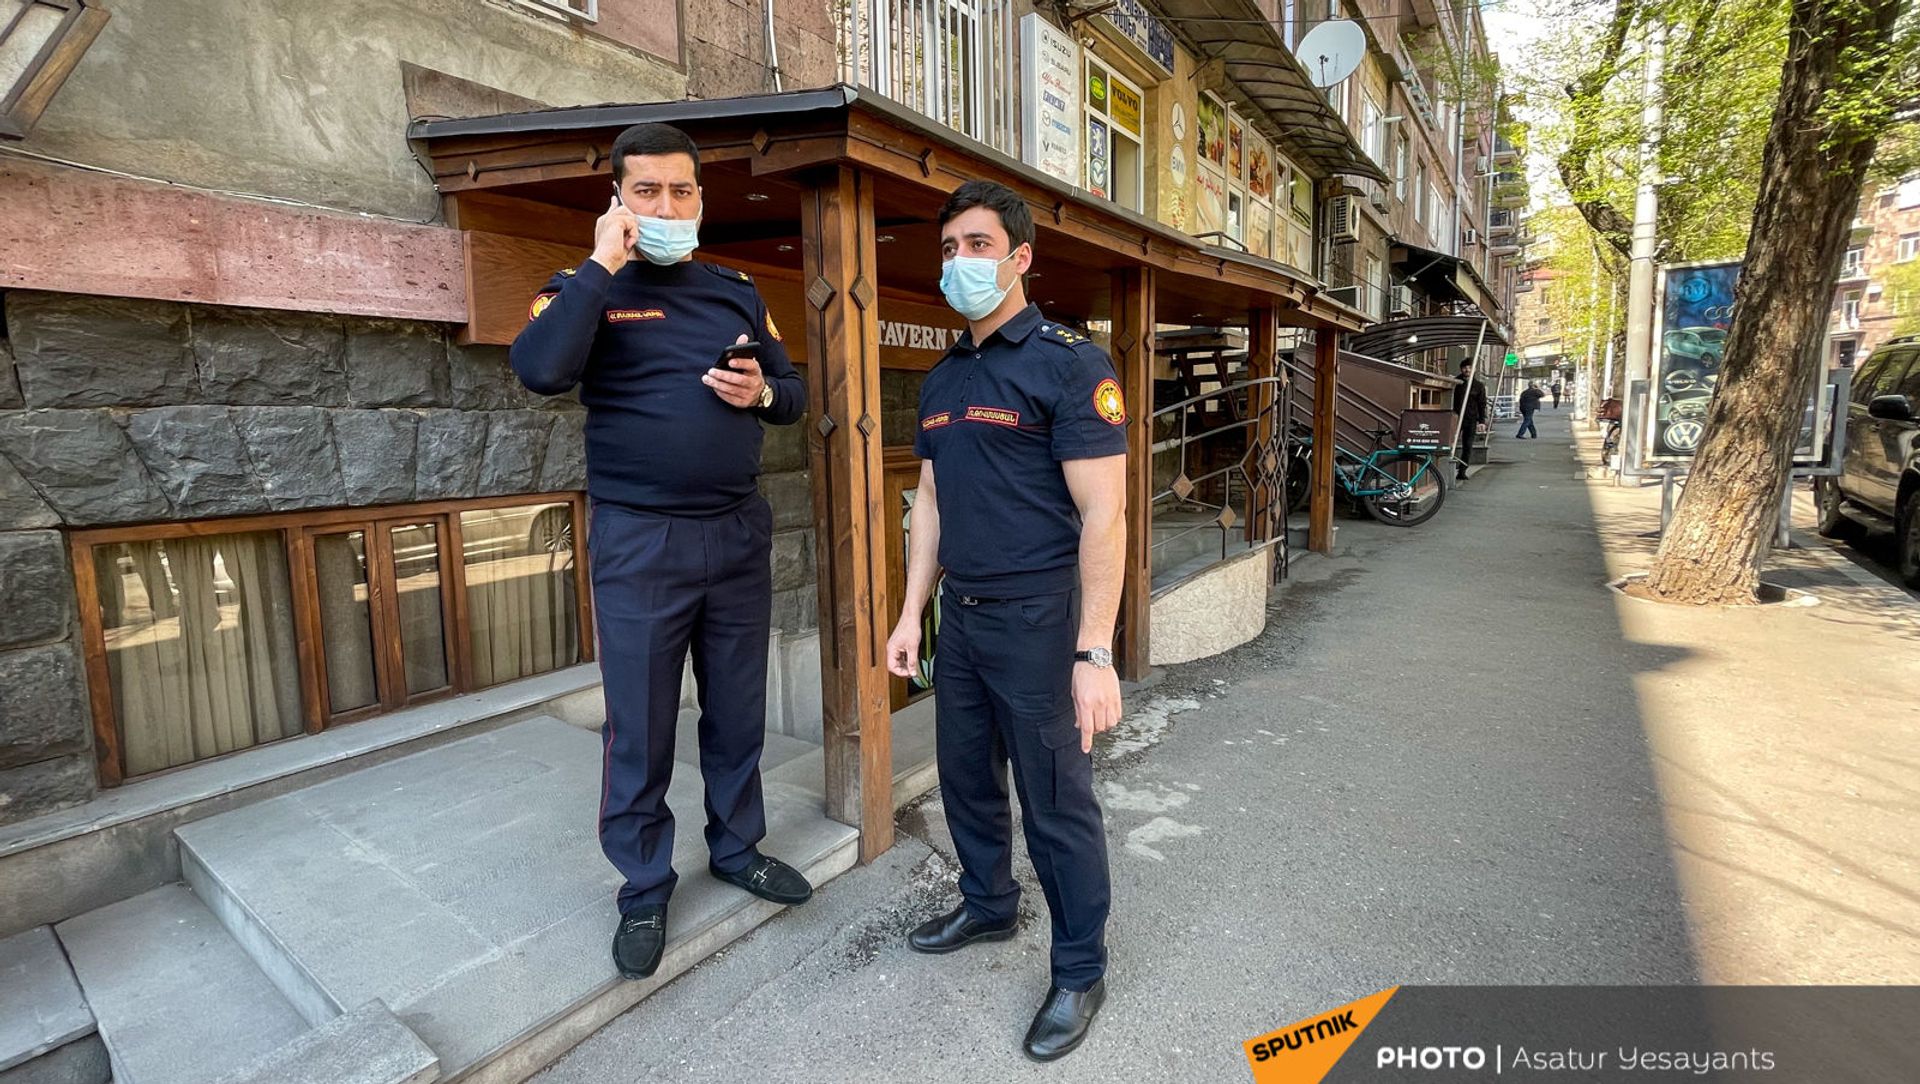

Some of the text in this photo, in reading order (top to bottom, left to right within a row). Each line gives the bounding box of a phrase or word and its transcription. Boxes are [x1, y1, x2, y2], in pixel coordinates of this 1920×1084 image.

[1050, 38, 1071, 58] ISUZU
[1111, 85, 1138, 112] VOLVO
[878, 320, 948, 350] TAVERN
